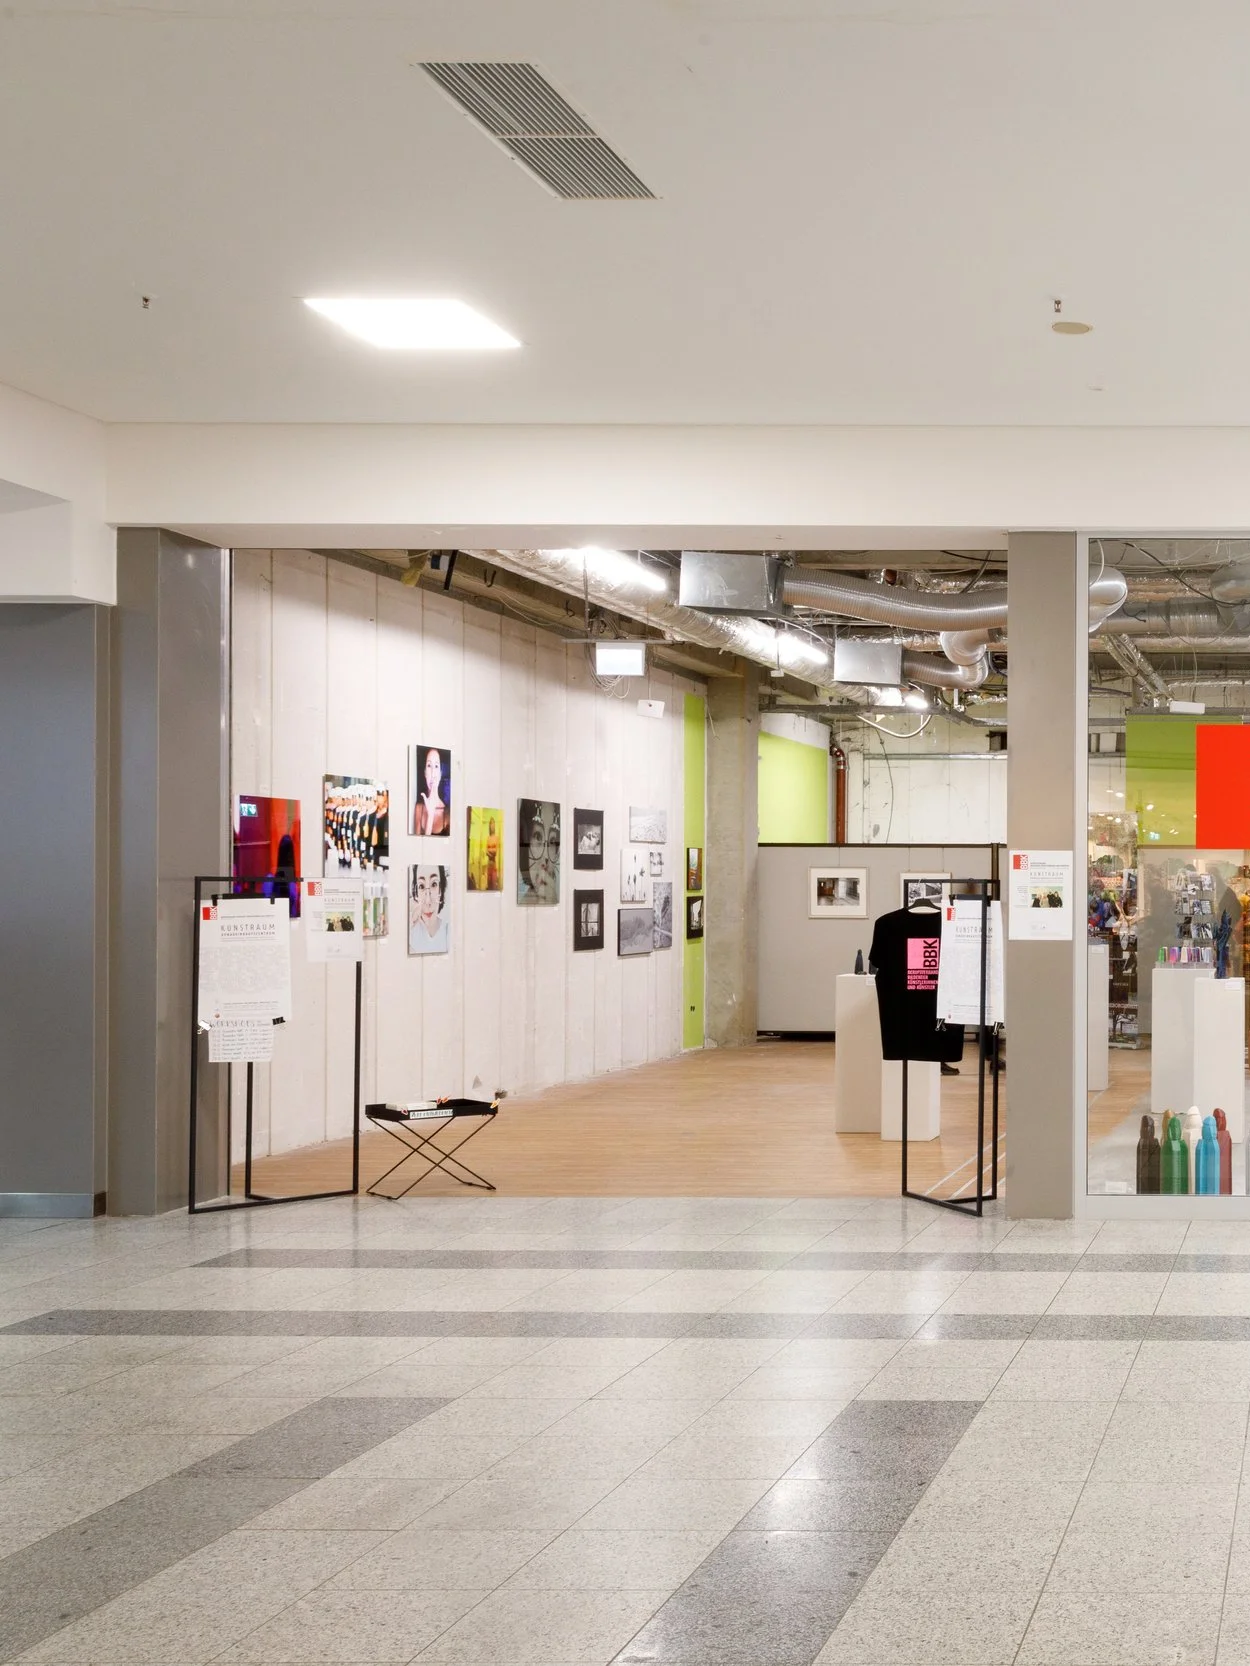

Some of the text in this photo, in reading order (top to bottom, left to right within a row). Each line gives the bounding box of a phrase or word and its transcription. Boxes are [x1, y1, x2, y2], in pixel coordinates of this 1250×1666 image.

[1020, 855, 1028, 870] BBK
[220, 923, 276, 932] KUNSTRAUM
[923, 939, 938, 968] BBK
